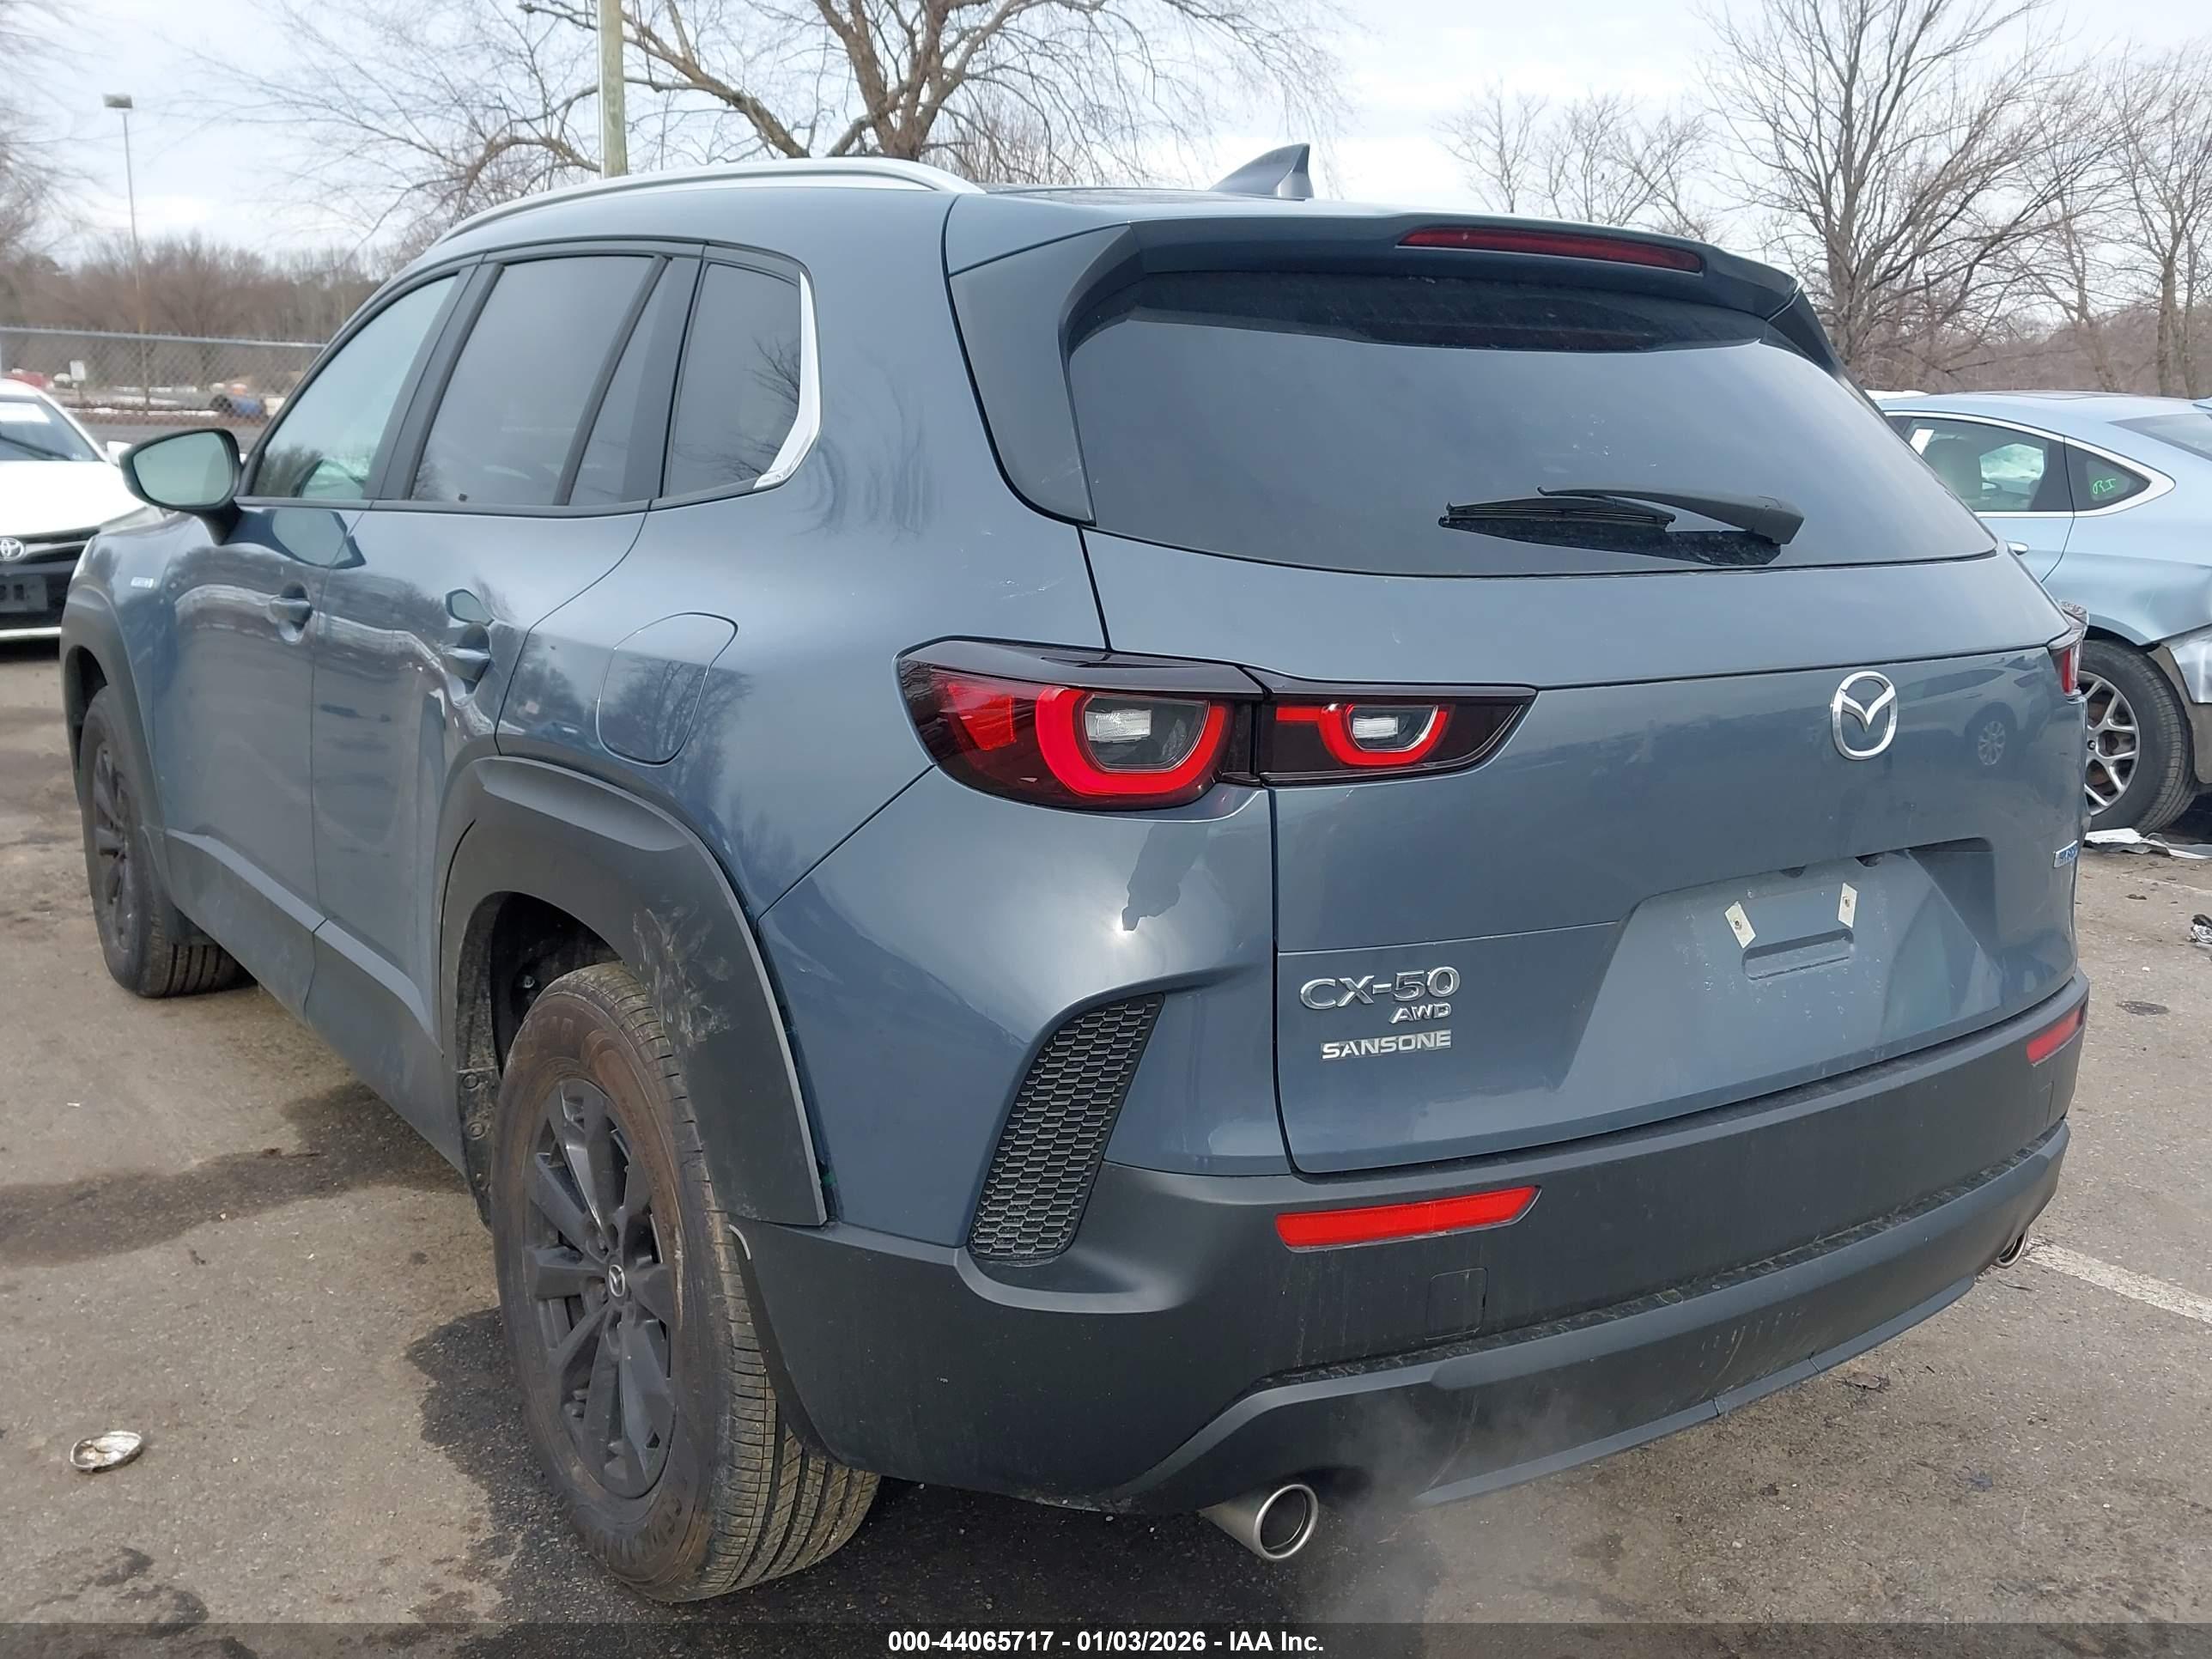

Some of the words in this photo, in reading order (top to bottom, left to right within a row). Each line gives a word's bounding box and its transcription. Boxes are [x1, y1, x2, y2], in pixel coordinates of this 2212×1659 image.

[1299, 966, 1461, 1010] CX-50
[1389, 1002, 1453, 1024] AWD
[1321, 1030, 1452, 1060] SANSONE
